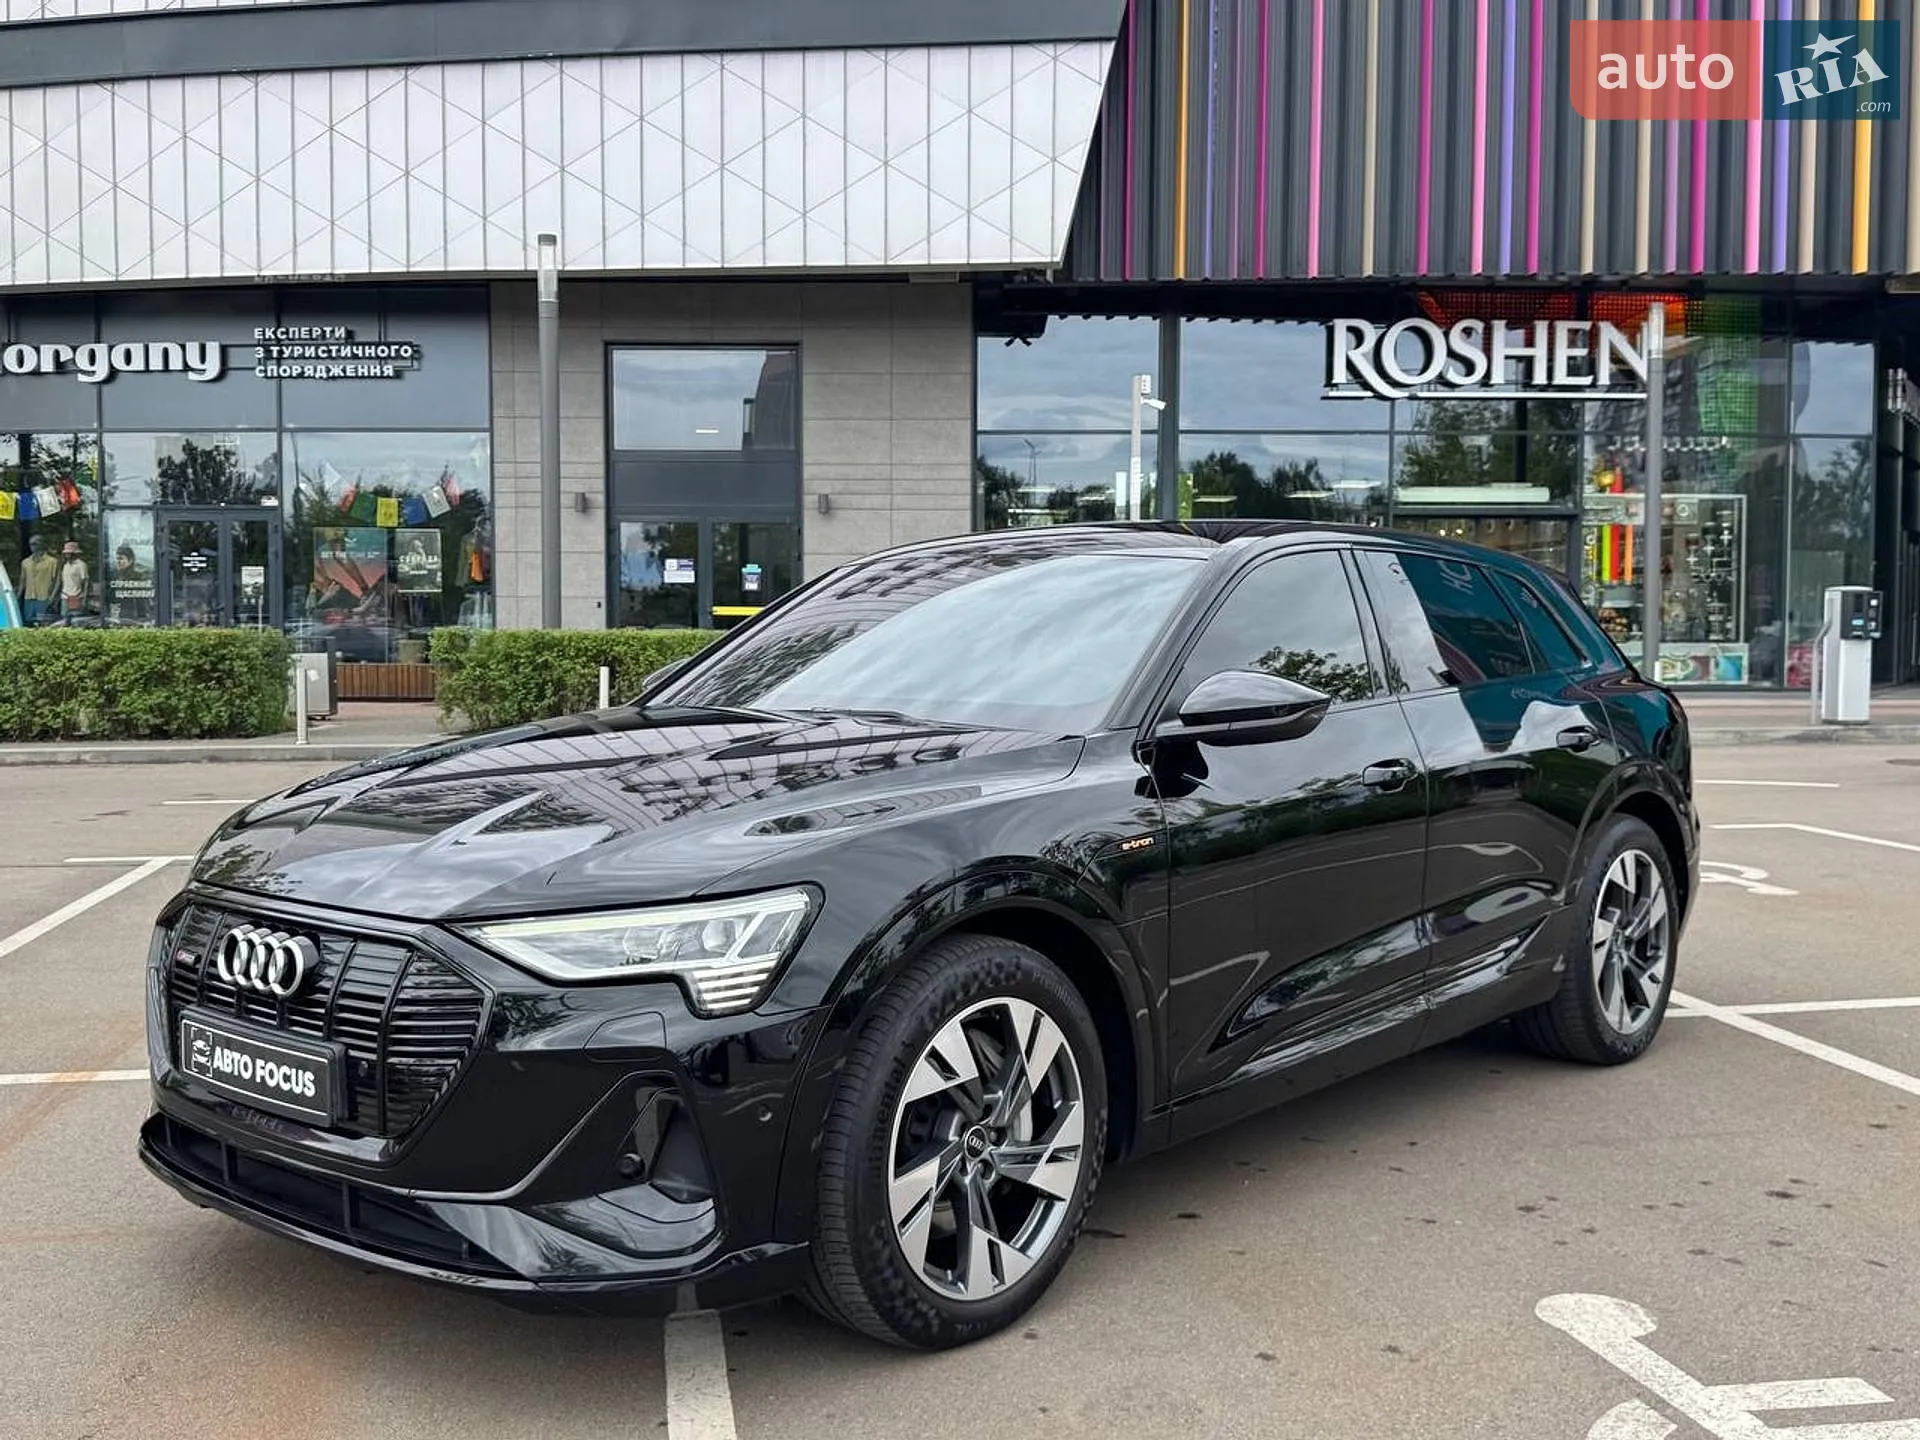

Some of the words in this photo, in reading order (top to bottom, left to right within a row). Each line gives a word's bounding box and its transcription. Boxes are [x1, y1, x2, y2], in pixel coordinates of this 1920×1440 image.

[254, 326, 346, 339] ЕКСПЕРТИ
[3, 342, 221, 382] organy
[271, 345, 413, 358] ТУРИСТИЧНОГО
[1329, 318, 1648, 398] ROSHEN
[255, 365, 394, 378] СПОРЯДЖЕННЯ
[255, 1058, 316, 1097] FOCUS
